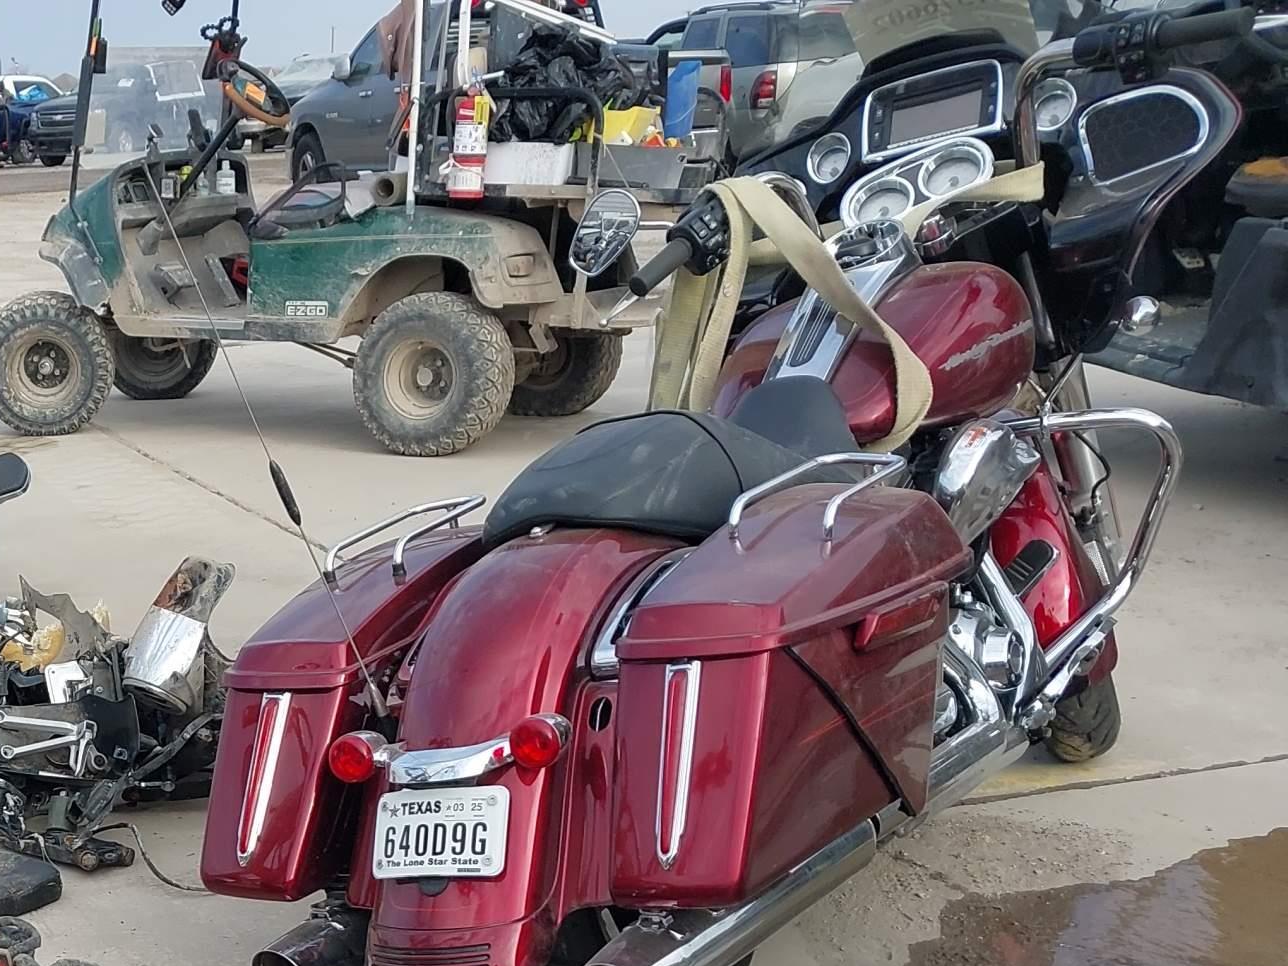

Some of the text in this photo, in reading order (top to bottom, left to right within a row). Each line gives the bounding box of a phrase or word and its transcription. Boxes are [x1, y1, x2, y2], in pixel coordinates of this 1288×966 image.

[401, 800, 442, 816] TEXAS
[384, 822, 488, 859] 640D9G
[386, 857, 479, 868] The Lone Star State
